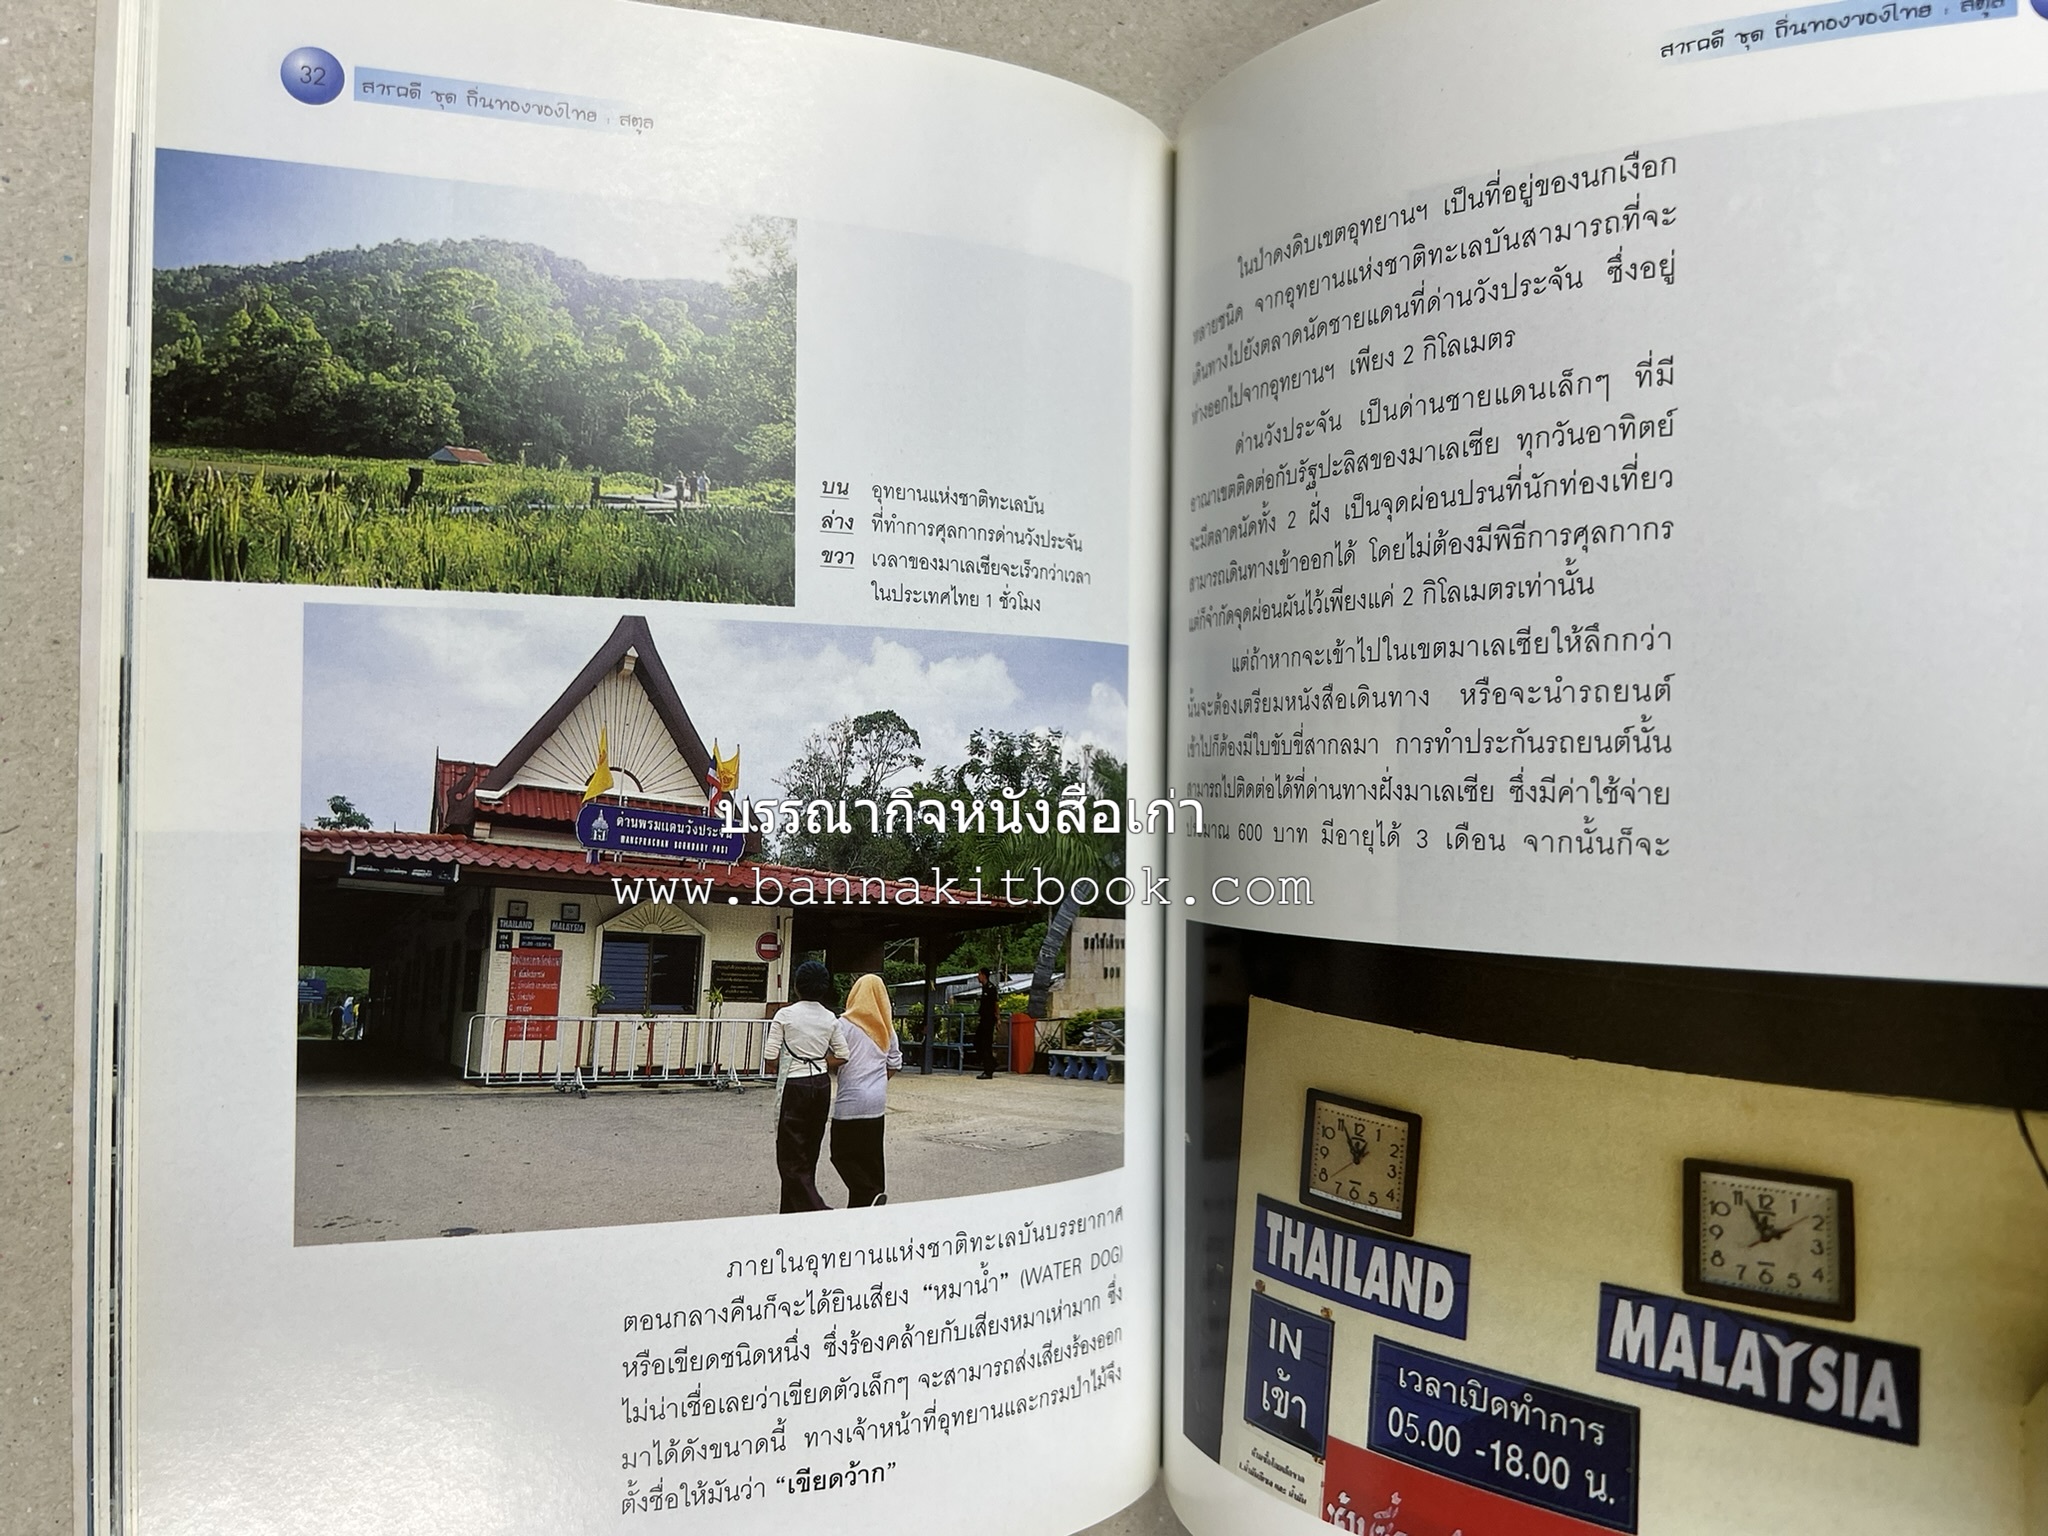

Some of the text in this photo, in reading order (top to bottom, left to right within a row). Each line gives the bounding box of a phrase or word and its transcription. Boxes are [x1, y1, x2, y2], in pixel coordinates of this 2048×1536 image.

[1735, 29, 1764, 51] ชุด
[1775, 4, 1932, 39] ถิ่นทองของไทย
[300, 65, 326, 86] 32
[431, 90, 456, 110] ชุด
[467, 86, 597, 122] ถิ่นทองของไทย
[620, 114, 654, 135] สตูล
[1237, 150, 1676, 279] ในป่าดงดิบเขตอุทยานฯ เป็นที่อยู่ของนกเงือก
[1255, 193, 1676, 312] จากอุทยานแห่งชาติทะเลบันสามารถที่จะ
[1607, 246, 1675, 285] ซึ่งอยู่
[1350, 345, 1395, 377] เพียง
[1404, 344, 1414, 365] 2
[1423, 328, 1516, 361] กิโลเมตร
[1235, 350, 1675, 455] ด่านวังประจัน เป็นด่านชายแดนเล็กๆ ที่มี
[1517, 408, 1678, 457] ทุกวันอาทิตย์
[822, 480, 1044, 515] บน อุทยานแห่งชาติทะเลบัน
[1288, 511, 1297, 529] 2
[1310, 492, 1330, 525] ฝั่ง
[1344, 453, 1675, 522] เป็นจุดผ่อนปรนที่นักท่องเที่ยว
[821, 506, 1083, 552] ล่าง ที่ทำการศุลกากรด่านวังประจัน
[1369, 517, 1675, 563] โดยไม่ต้องมีพิธีการศุลกากร
[821, 549, 1091, 585] ขวา เวลาของมาเลเซียจะเร็วกว่าเวลา
[1403, 586, 1413, 606] 2
[1423, 559, 1594, 605] กิโลเมตรเท่านั้น
[871, 581, 1041, 612] ในประเทศไทย 1 ชั่วโมง
[1232, 622, 1672, 672] แต่ถ้าหากจะเข้าไปในเขตมาเลเซียให้ลึกกว่า
[1460, 673, 1675, 707] หรือจะนำรถยนต์
[1395, 714, 1672, 755] การทำประกันรถยนต์นั้น
[1509, 767, 1669, 806] ซึ่งมีค่าใช้จ่าย
[1238, 823, 1262, 841] 600
[1273, 826, 1308, 843] บาท
[1322, 819, 1400, 854] มีอายุได้
[1416, 829, 1428, 848] 3
[1446, 821, 1505, 852] เดือน
[1523, 815, 1670, 857] จากนั้นก็จะ
[1321, 1125, 1335, 1140] 10
[1337, 1118, 1345, 1132] 11
[1354, 1123, 1366, 1137] 12
[1376, 1128, 1381, 1141] 1
[1320, 1146, 1329, 1159] 9
[1390, 1144, 1399, 1158] 2
[1319, 1167, 1328, 1182] 8
[1335, 1181, 1342, 1194] 7
[1387, 1164, 1397, 1178] 3
[1349, 1186, 1359, 1200] 6
[1368, 1191, 1378, 1205] 5
[1386, 1188, 1394, 1202] 4
[1709, 1200, 1731, 1216] 10
[1732, 1190, 1743, 1206] 11
[1758, 1194, 1774, 1210] 12
[1791, 1199, 1797, 1214] 1
[1709, 1224, 1724, 1240] 9
[1812, 1215, 1825, 1231] 2
[727, 1205, 1124, 1278] ภายในอุทยานแห่งชาติทะเลบันบรรยากาศ
[1710, 1250, 1725, 1267] 8
[1810, 1239, 1824, 1255] 3
[1266, 1210, 1454, 1322] THAILAND
[1736, 1264, 1747, 1280] 7
[1758, 1268, 1774, 1285] 6
[1787, 1272, 1801, 1289] 5
[1812, 1267, 1824, 1283] 4
[624, 1281, 909, 1332] ตอนกลางคืนก็จะได้ยินเสียง
[1019, 1257, 1082, 1288] (WATER
[1091, 1245, 1123, 1270] DOG)
[622, 1328, 810, 1378] หรือเขียดชนิดหนึ่ง
[823, 1294, 1100, 1358] ซึ่งร้องคล้ายกับเสียงหมาเห่ามาก
[1269, 1317, 1303, 1361] IN
[621, 1327, 1122, 1423] ไม่น่าเชื่อเลยว่าเขียดตัวเล็กๆ จะสามารถส่งเสียงร้องออก
[1609, 1298, 1902, 1429] MALAYSIA
[622, 1360, 1122, 1469] มาได้ดังขนาดนี้ ทางเจ้าหน้าที่อุทยานและกรมป่าไม้จึง
[1261, 1367, 1307, 1428] เข้า
[1398, 1367, 1605, 1446] เวลาเปิดทำการ
[1388, 1406, 1615, 1504] 05.00 -18.00 น.
[621, 1460, 896, 1515] ตั้งชื่อให้มันว่า “เขียดว้าก”
